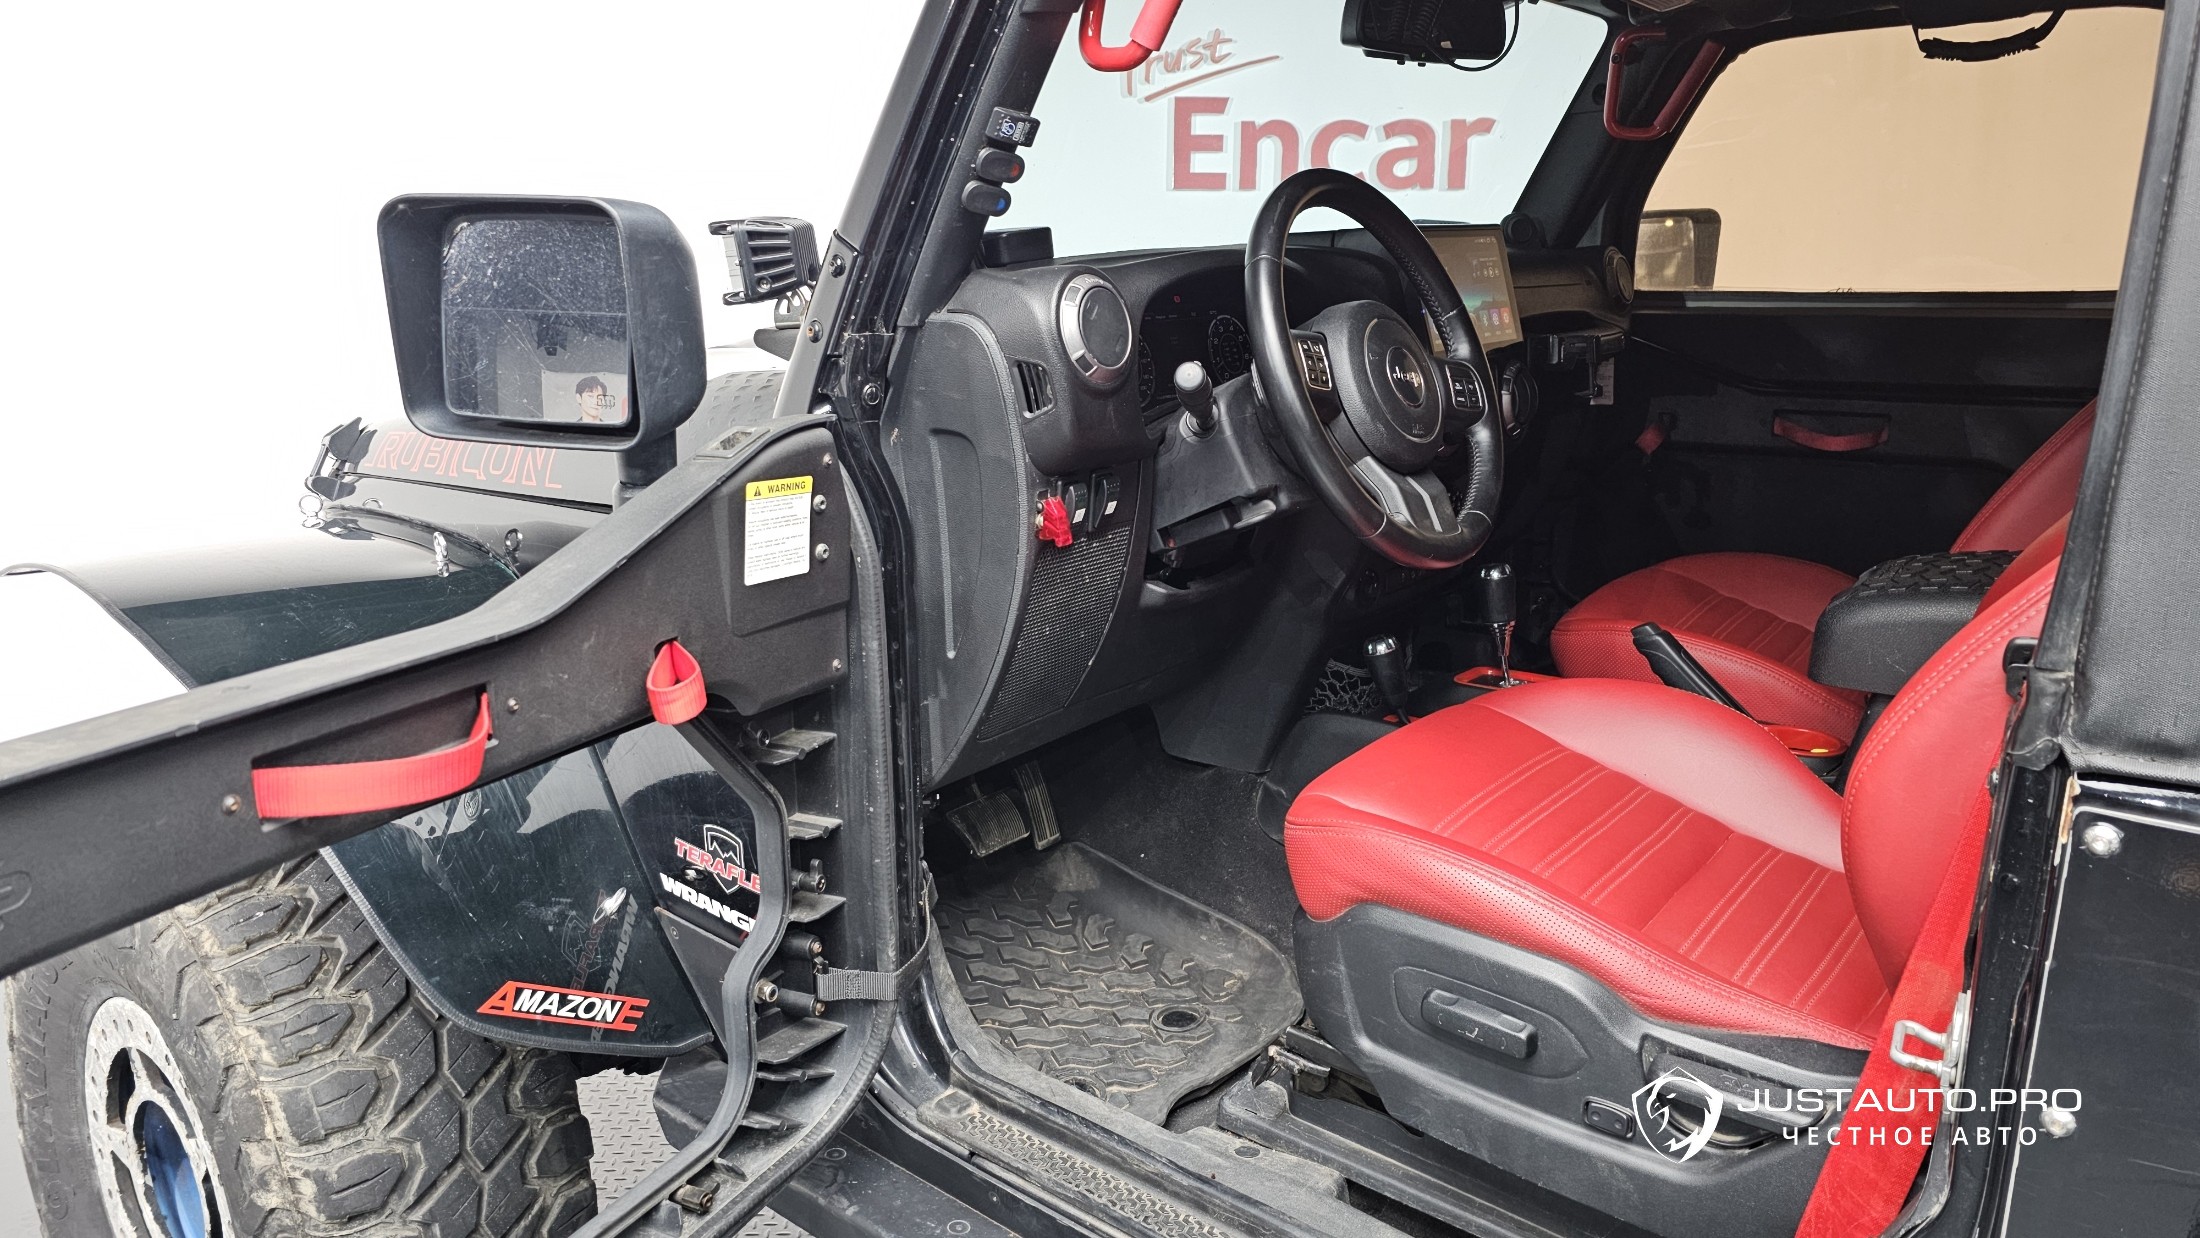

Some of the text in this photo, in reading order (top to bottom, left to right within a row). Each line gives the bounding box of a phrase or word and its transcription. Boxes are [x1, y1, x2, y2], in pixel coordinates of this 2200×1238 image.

[1169, 96, 1497, 191] Encar
[364, 431, 562, 489] RUBICON
[767, 481, 806, 494] WARNING
[477, 980, 650, 1032] AMAZONE
